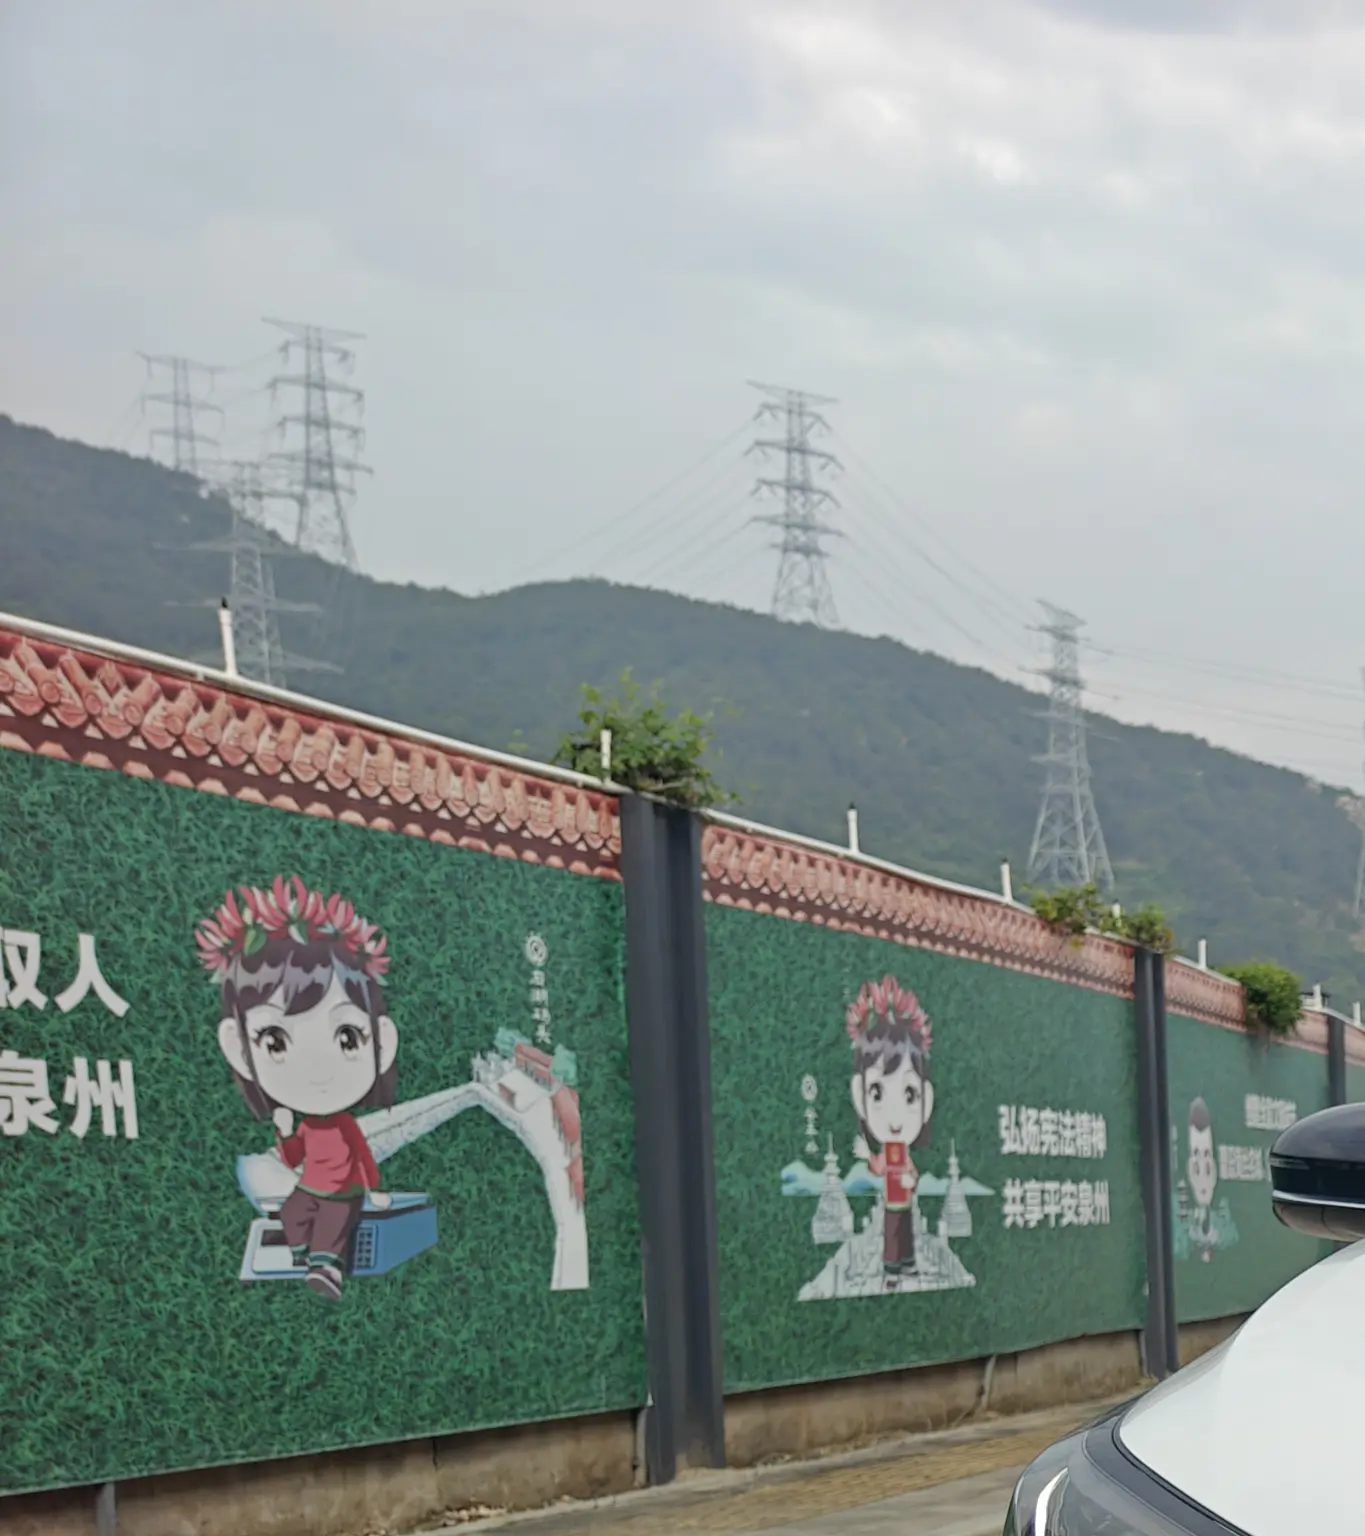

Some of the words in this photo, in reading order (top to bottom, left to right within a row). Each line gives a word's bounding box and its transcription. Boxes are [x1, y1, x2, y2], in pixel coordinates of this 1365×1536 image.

[0, 1050, 139, 1139] 泉州
[998, 1104, 1107, 1159] 弘扬宪法精神
[1003, 1177, 1110, 1228] 共享平安泉州
